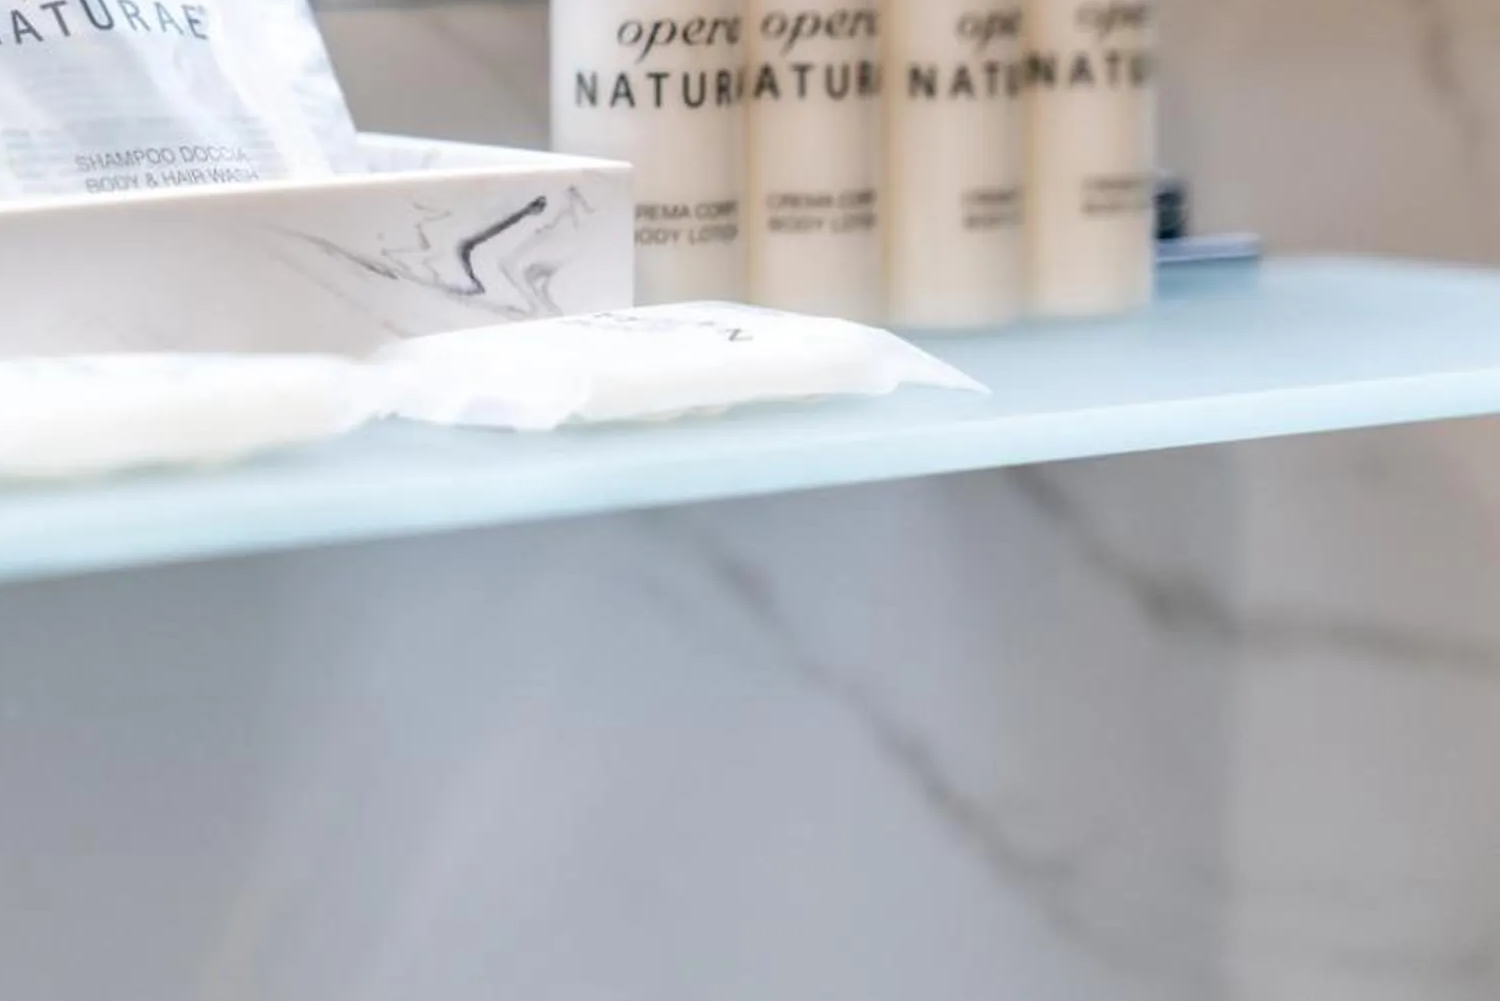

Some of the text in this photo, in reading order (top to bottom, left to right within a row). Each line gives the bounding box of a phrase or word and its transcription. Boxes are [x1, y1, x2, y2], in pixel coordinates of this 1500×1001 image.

[574, 68, 743, 108] NATUR
[753, 60, 882, 101] ATUR
[75, 149, 177, 173] SHAMPOO
[85, 175, 139, 194] BODY
[144, 172, 158, 189] &
[161, 167, 207, 187] HAIR
[634, 203, 690, 221] REMA
